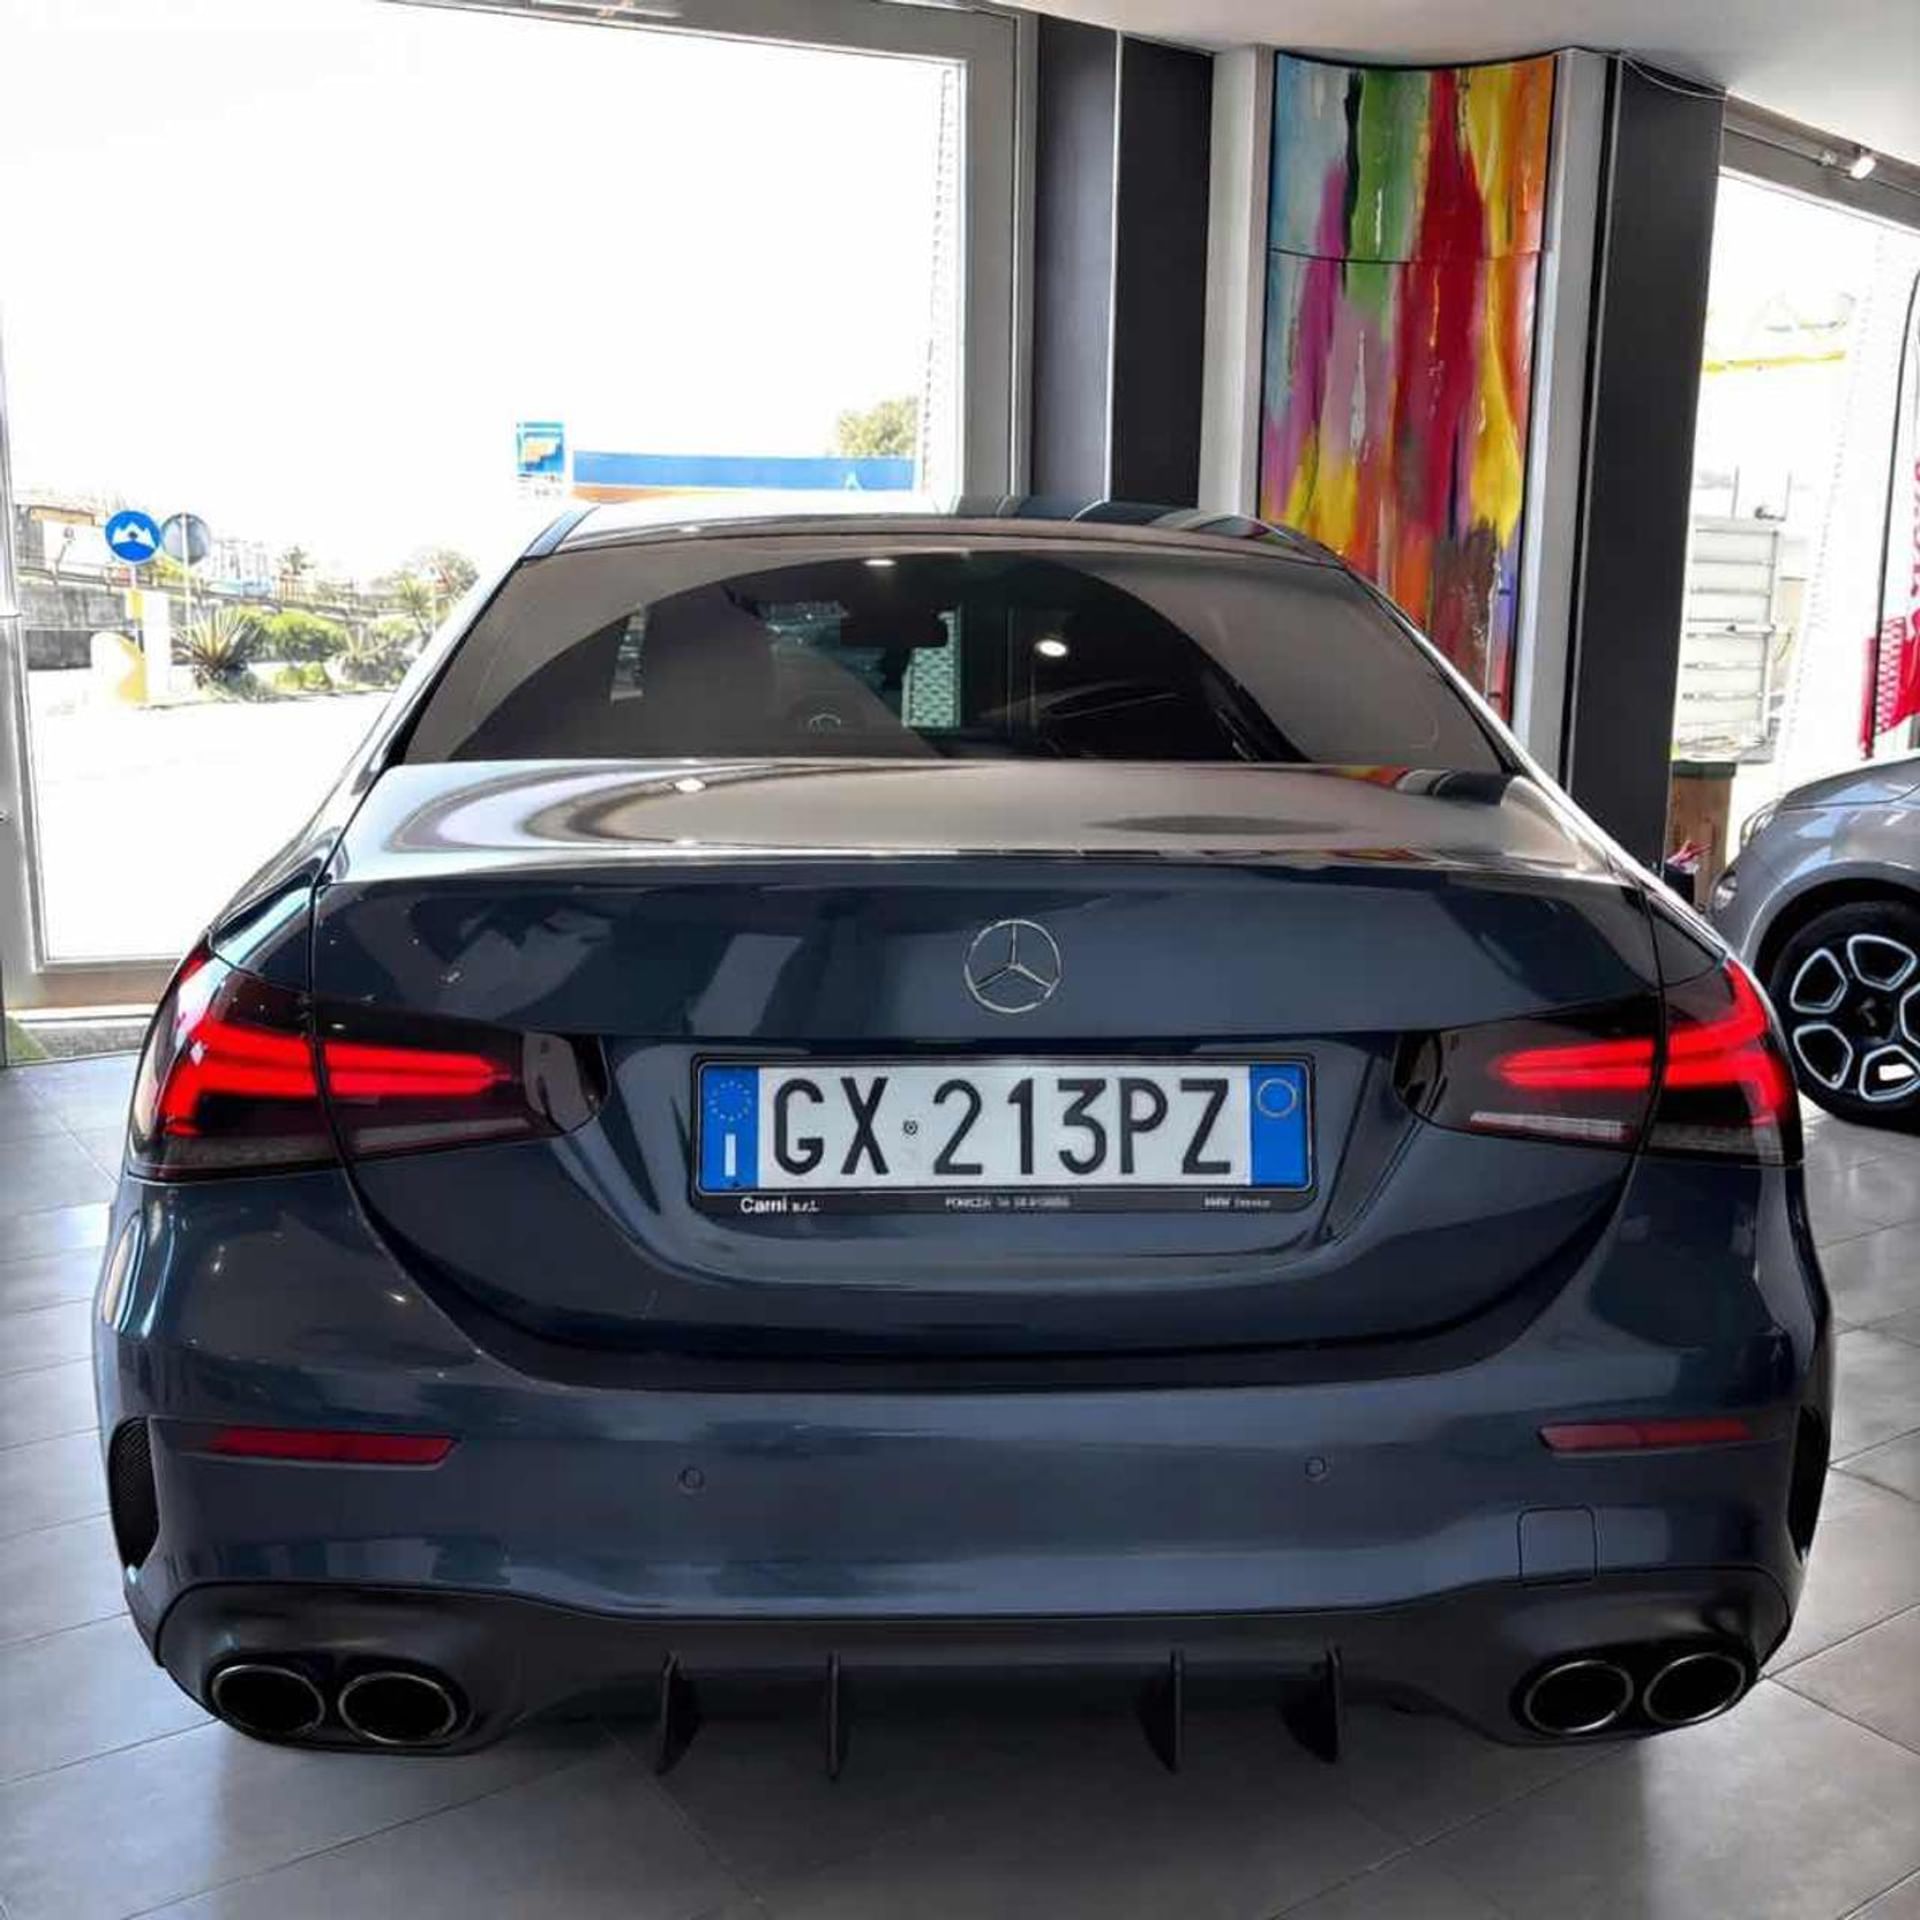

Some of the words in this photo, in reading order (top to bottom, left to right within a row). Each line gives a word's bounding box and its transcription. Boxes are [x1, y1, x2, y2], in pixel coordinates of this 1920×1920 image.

[725, 1134, 736, 1176] I
[774, 1077, 889, 1176] GX
[933, 1077, 1231, 1176] 213PZ
